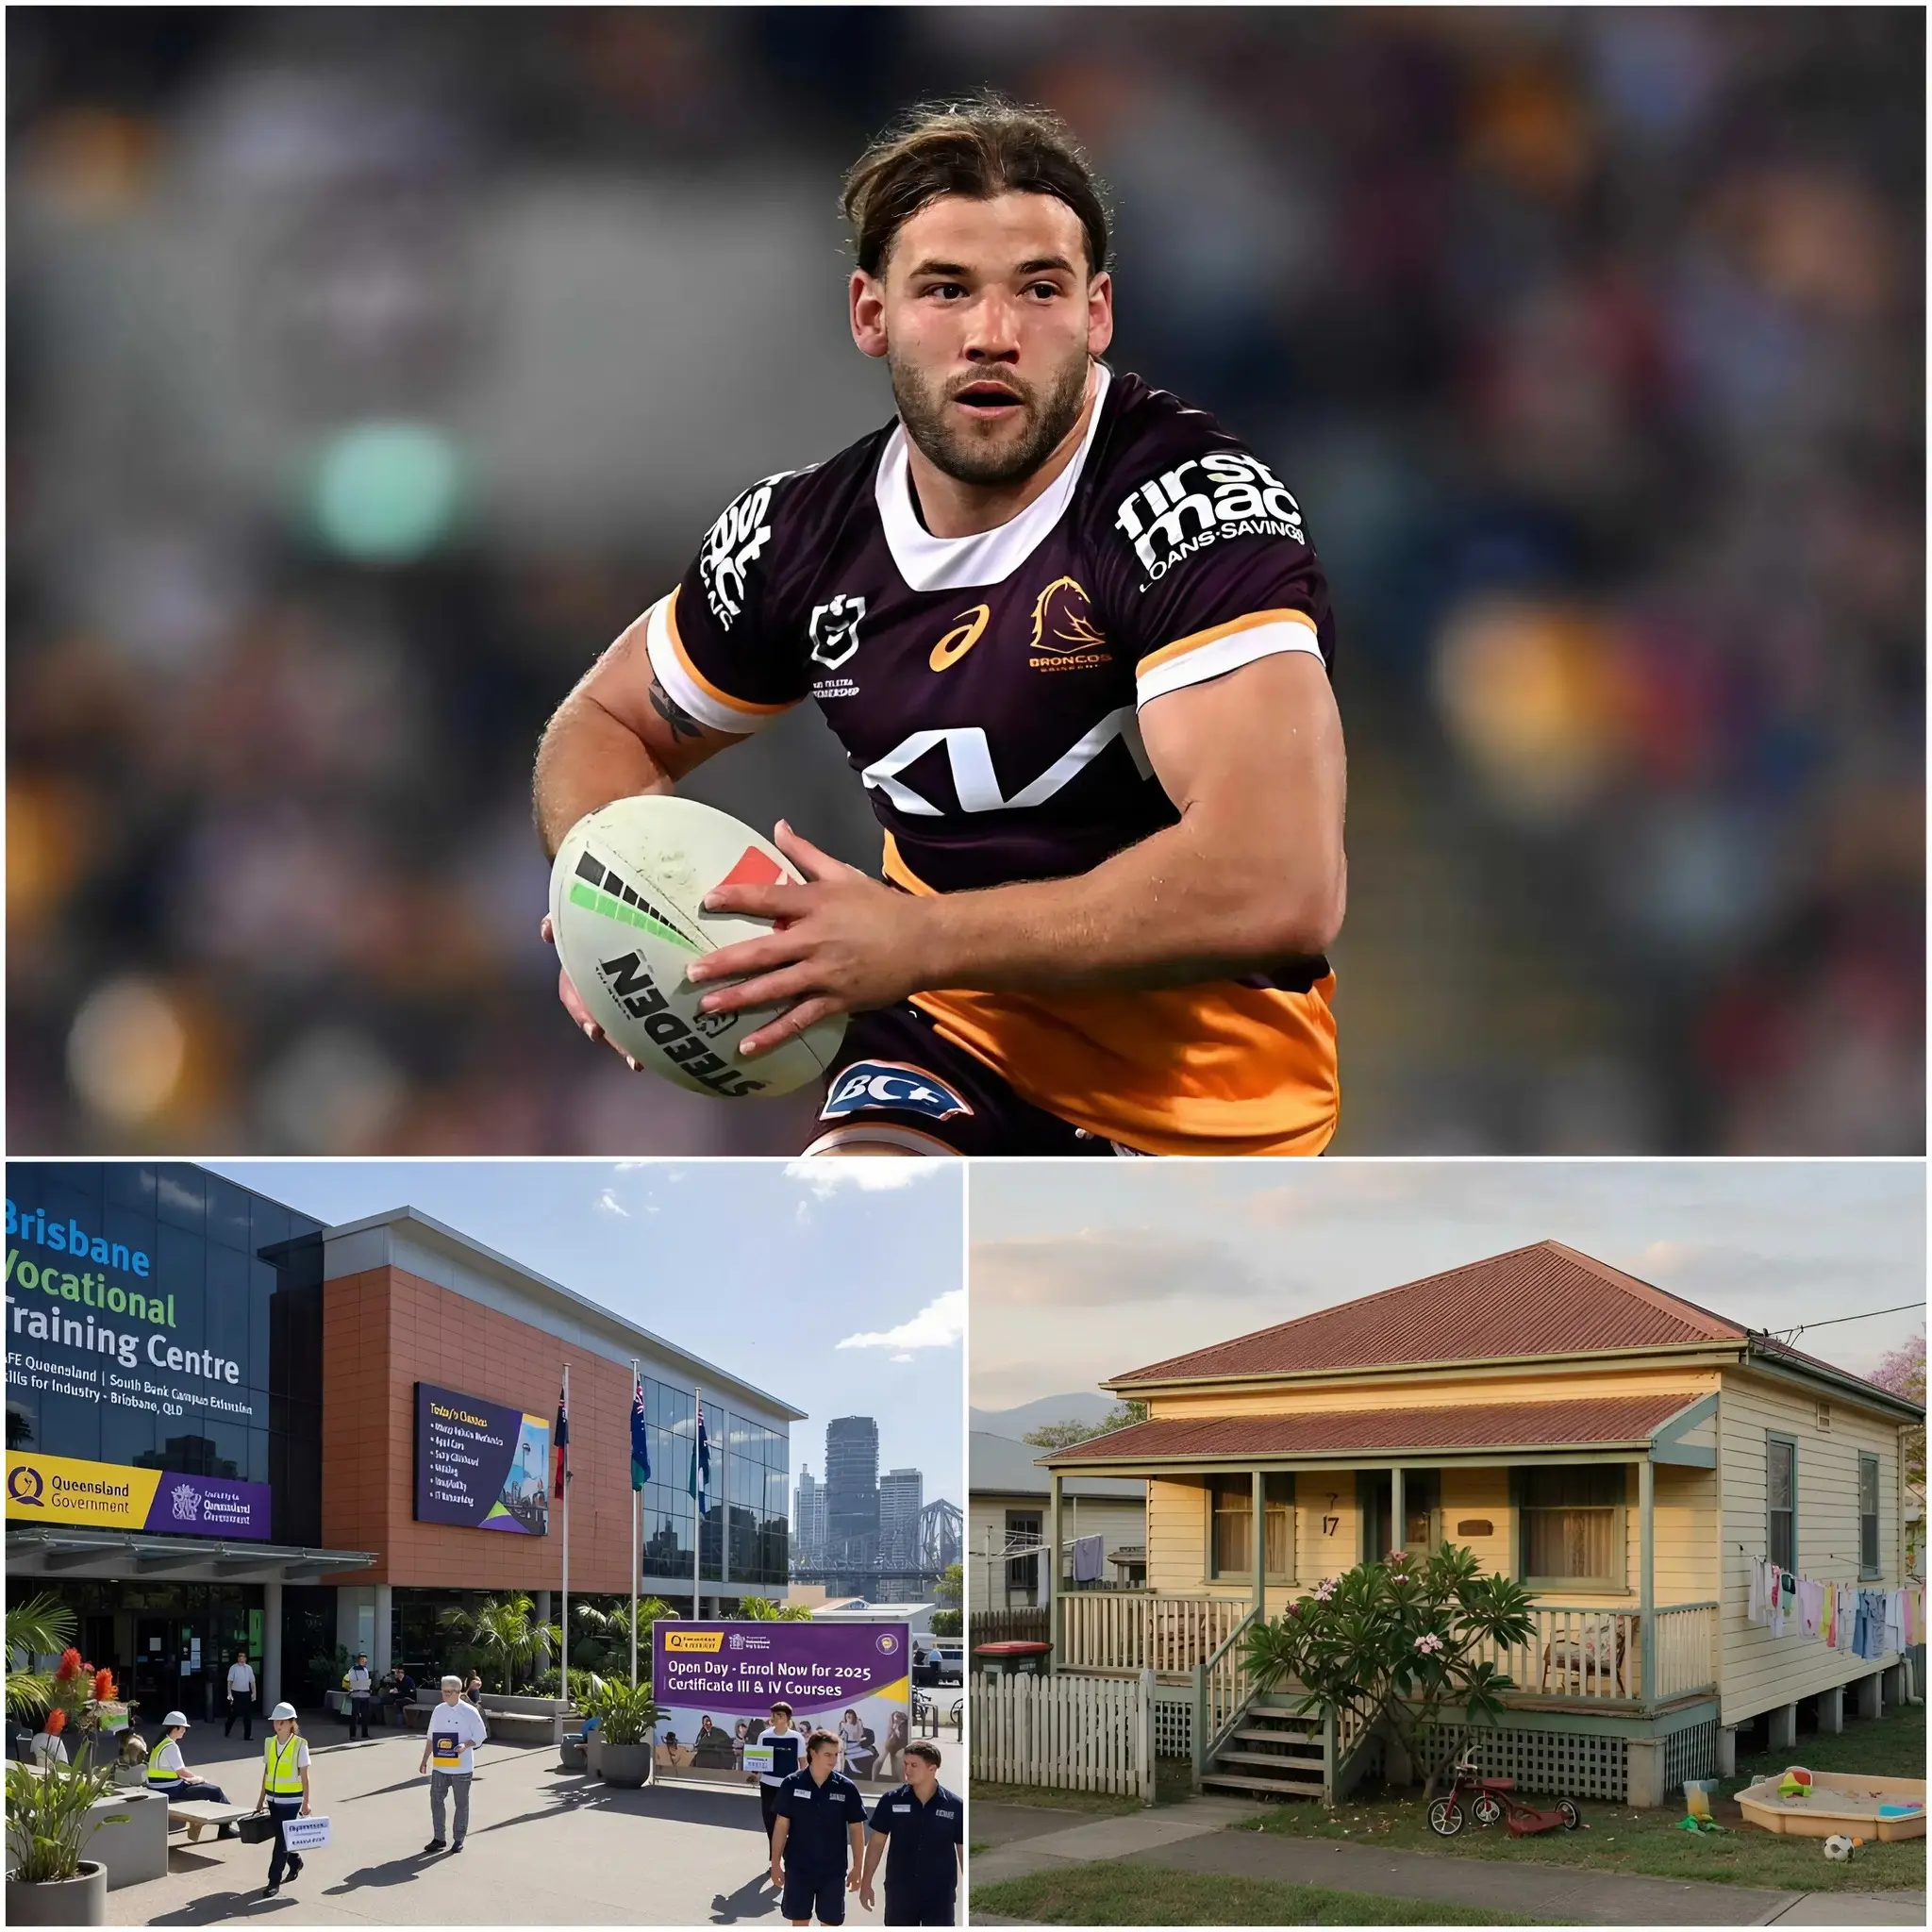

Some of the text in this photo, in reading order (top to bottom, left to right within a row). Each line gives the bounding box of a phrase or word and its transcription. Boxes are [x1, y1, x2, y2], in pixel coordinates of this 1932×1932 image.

[1114, 454, 1285, 541] first
[1134, 483, 1302, 571] mac
[601, 952, 766, 1097] STEEDEN
[832, 1074, 945, 1106] BCF
[147, 1334, 240, 1384] Centre
[31, 1375, 48, 1390] for
[52, 1381, 101, 1404] Industry
[162, 1402, 183, 1416] QLD
[110, 1374, 142, 1391] South
[52, 1475, 129, 1497] Queensland
[51, 1492, 129, 1514] Government
[1323, 1516, 1340, 1537] 17
[668, 1660, 700, 1675] Open
[705, 1661, 728, 1676] Day
[740, 1661, 774, 1675] Enrol
[777, 1662, 808, 1676] Now
[811, 1663, 831, 1676] for
[834, 1667, 872, 1681] 2025
[668, 1677, 842, 1696] Certificate III & IV Courses
